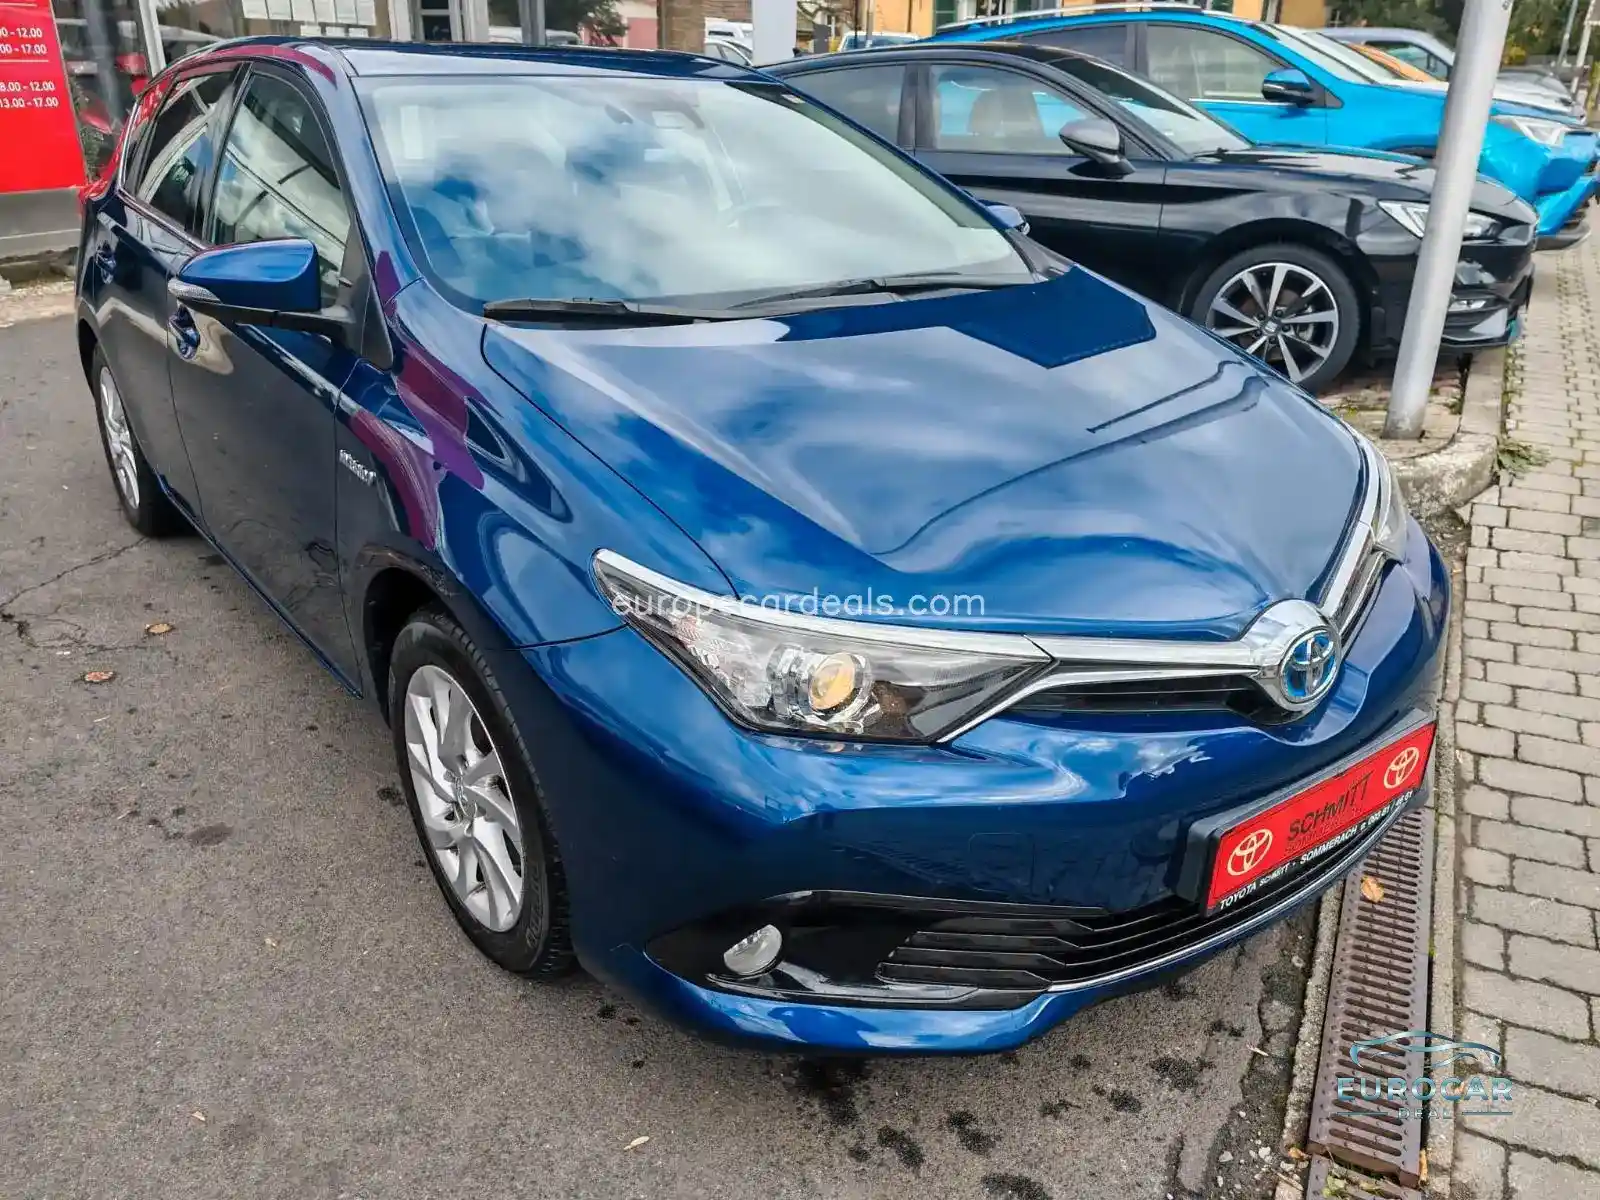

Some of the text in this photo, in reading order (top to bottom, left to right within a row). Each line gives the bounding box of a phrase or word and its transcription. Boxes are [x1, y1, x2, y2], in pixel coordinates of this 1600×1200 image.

[16, 27, 42, 38] 12.00
[21, 44, 47, 55] 17.00
[29, 81, 55, 92] 12.00
[33, 97, 59, 108] 17.00
[1288, 769, 1376, 842] SCHMITT
[1220, 881, 1257, 910] TOYOTA
